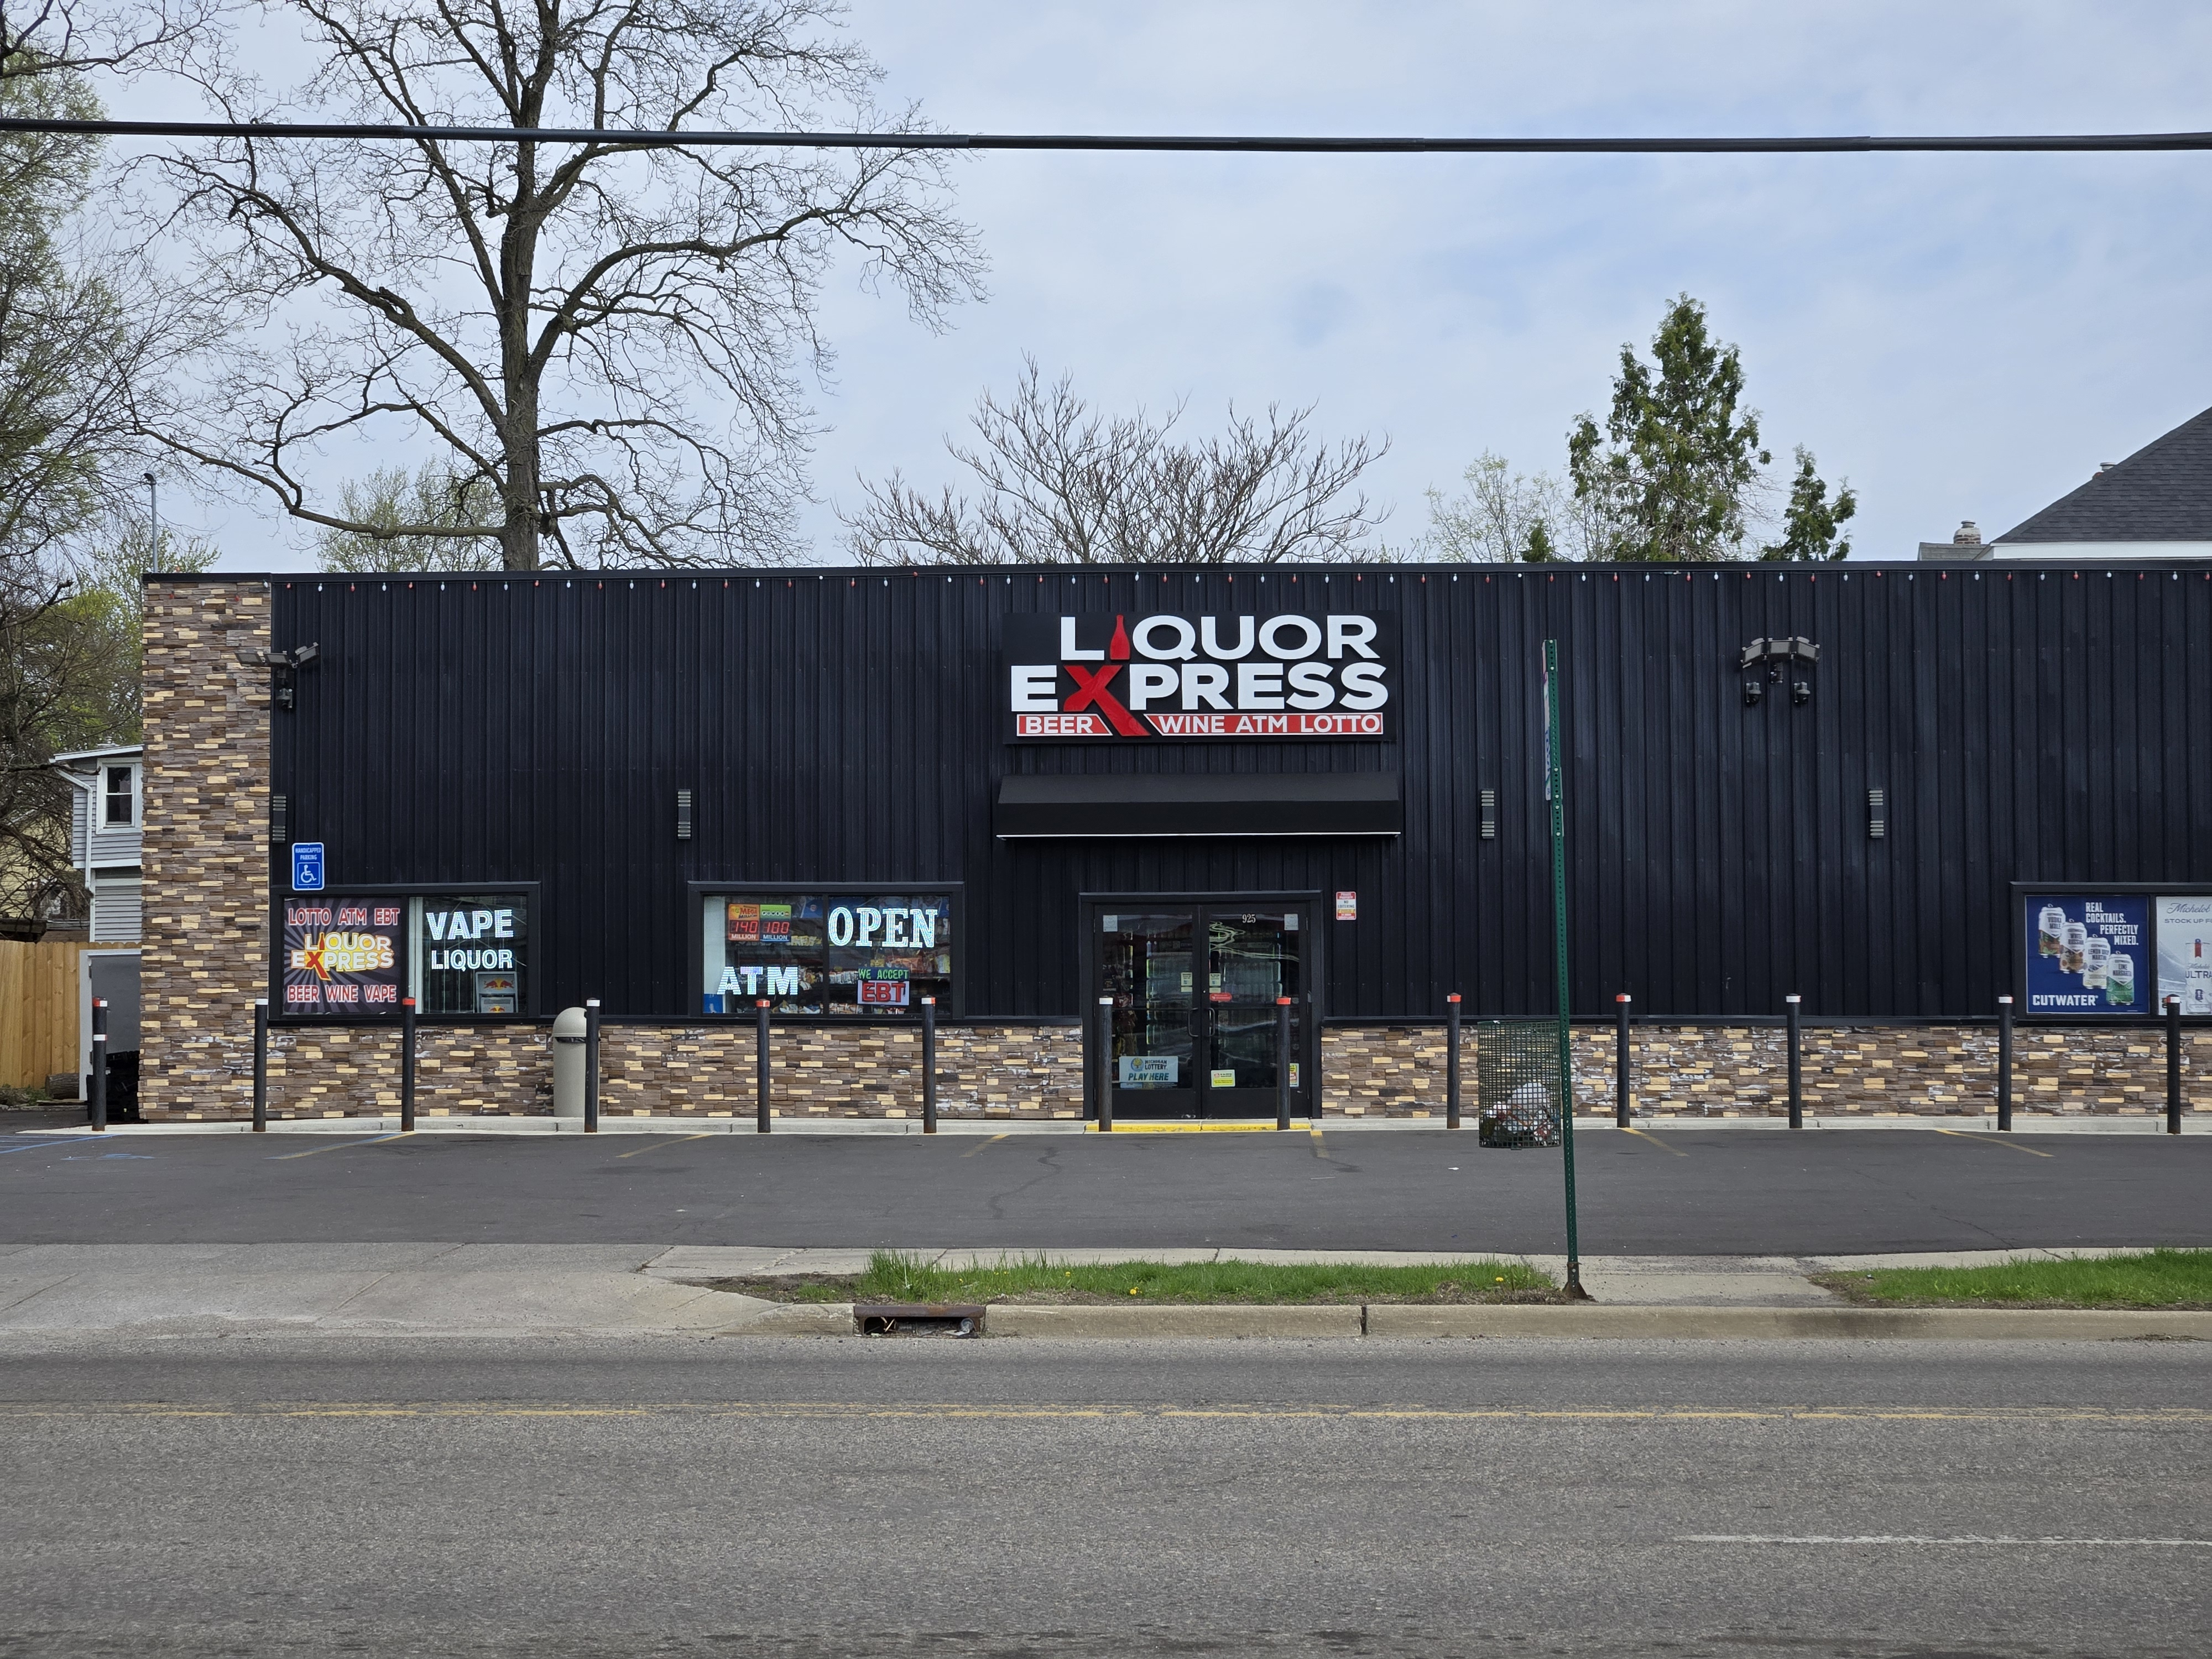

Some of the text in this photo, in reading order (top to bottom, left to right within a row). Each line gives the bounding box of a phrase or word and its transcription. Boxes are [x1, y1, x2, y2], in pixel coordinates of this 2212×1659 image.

[1061, 614, 1381, 661] LIQUOR
[1011, 662, 1389, 736] EXPRESS
[1025, 714, 1381, 734] BEER WINE ATM LOTTO
[2085, 902, 2104, 912] REAL
[289, 907, 400, 926] LOTTO ATM EBT
[426, 909, 514, 940] VAPE
[1242, 914, 1256, 923] 925
[2085, 913, 2126, 923] COCKTAILS.
[735, 921, 758, 933] 140
[766, 922, 790, 933] 100
[828, 906, 938, 948] OPEN
[2100, 925, 2138, 935] PERFECTLY
[305, 932, 392, 951] LIQUOR
[2114, 935, 2139, 945] MIXED.
[292, 951, 394, 979] EXPRESS
[431, 949, 513, 972] LIQUOR
[717, 966, 798, 995] ATM
[858, 968, 909, 979] WE ACCEPT
[288, 985, 397, 1003] BEER WINE VAPE
[862, 982, 906, 1003] EBT
[2032, 994, 2096, 1006] CUTWATER
[1128, 1073, 1148, 1081] PLAY
